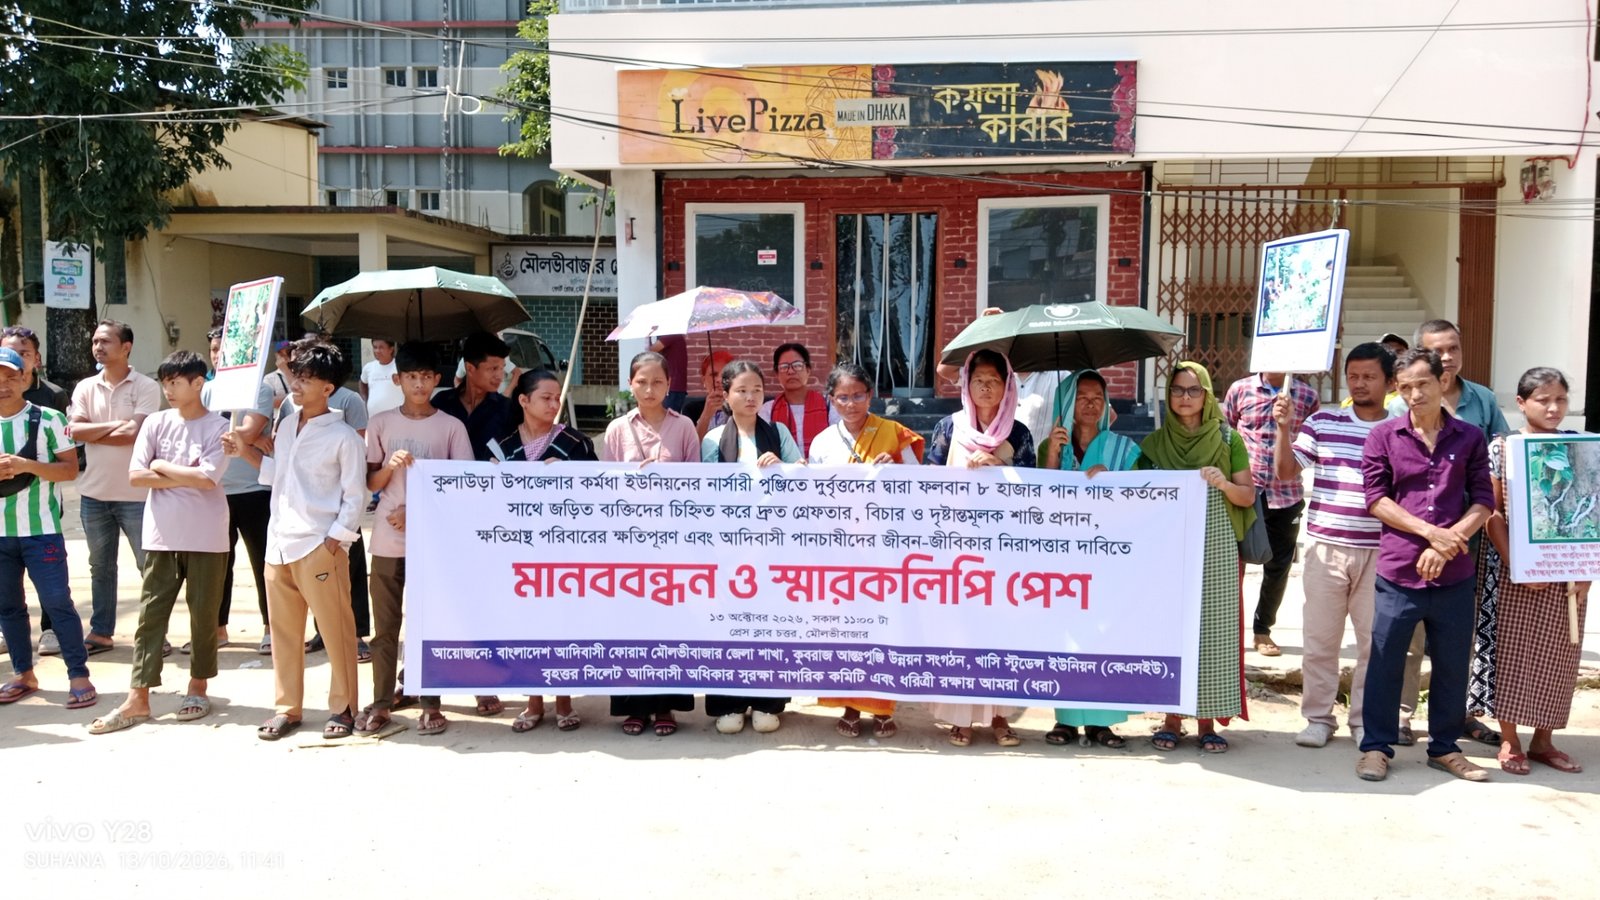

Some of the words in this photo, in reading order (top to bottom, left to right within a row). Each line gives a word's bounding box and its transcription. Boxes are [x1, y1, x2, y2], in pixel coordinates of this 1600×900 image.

[857, 110, 865, 121] IN
[867, 103, 906, 121] DHAKA
[932, 83, 1020, 114] কয়লা
[672, 97, 827, 133] LivePizza
[978, 112, 1073, 143] কাবাব
[432, 471, 495, 494] কুলাউড়া
[501, 472, 574, 490] উপজেলার
[579, 471, 620, 490] কর্মধা
[625, 472, 701, 491] ইউনিয়নের
[706, 472, 753, 492] নার্সারী
[759, 474, 810, 496] পুঞ্জিতে
[813, 474, 876, 499] দুর্বৃত্তদের
[881, 480, 912, 495] দ্বারা
[917, 480, 971, 496] ফলবান
[977, 482, 989, 495] ৮
[996, 482, 1043, 498] হাজার
[1049, 484, 1079, 499] পান
[1085, 484, 1115, 502] গাছ
[1119, 482, 1180, 501] কর্তনের
[507, 502, 543, 517] সাথে
[548, 498, 594, 520] জড়িত
[599, 498, 664, 518] ব্যক্তিদের
[669, 499, 715, 520] চিহ্নিত
[720, 504, 752, 519] করে
[756, 505, 788, 521] দ্রুত
[865, 502, 905, 521] বিচার
[911, 508, 924, 521] ও
[929, 503, 1004, 528] দৃষ্টান্তমূলক
[1010, 506, 1044, 525] শাস্তি
[539, 525, 608, 544] পরিবারের
[612, 526, 678, 549] ক্ষতিপূরণ
[684, 530, 715, 547] এবং
[719, 527, 786, 546] আদিবাসী
[791, 528, 876, 548] পানচাষীদের
[881, 528, 993, 551] জীবন-জীবিকার
[998, 532, 1071, 554] নিরাপত্তার
[1076, 535, 1133, 556] দাবিতে
[512, 563, 718, 606] মানববন্ধন
[728, 564, 758, 599] ও
[769, 553, 996, 606] স্মারকলিপি
[1006, 571, 1093, 610] পেশ
[709, 613, 725, 622] ১৩
[728, 611, 769, 623] অক্টোবর
[812, 614, 840, 623] সকাল
[878, 614, 889, 626] টা
[729, 627, 749, 637] প্রেস
[753, 627, 772, 638] ক্লাব
[806, 626, 869, 640] মৌলভীবাজার
[496, 646, 550, 660] বাংলাদেশ
[554, 642, 606, 660] আদিবাসী
[608, 646, 648, 660] ফোরাম
[650, 643, 723, 660] মৌলভীবাজার
[726, 647, 754, 661] জেলা
[792, 649, 833, 665] কুবরাজ
[888, 649, 923, 668] উন্নয়ন
[975, 652, 1001, 669] খাসি
[1048, 656, 1097, 674] ইউনিয়ন
[541, 667, 580, 685] বৃহত্তর
[583, 664, 623, 680] সিলেট
[626, 664, 683, 681] আদিবাসী
[686, 665, 735, 681] অধিকার
[738, 669, 774, 685] সুরক্ষা
[778, 667, 824, 683] নাগরিক
[828, 668, 867, 684] কমিটি
[870, 673, 895, 687] এবং
[900, 671, 936, 688] ধরিত্রী
[939, 675, 976, 690] রক্ষায়
[979, 677, 1019, 692] আমরা
[1023, 678, 1061, 696] (ধরা)
